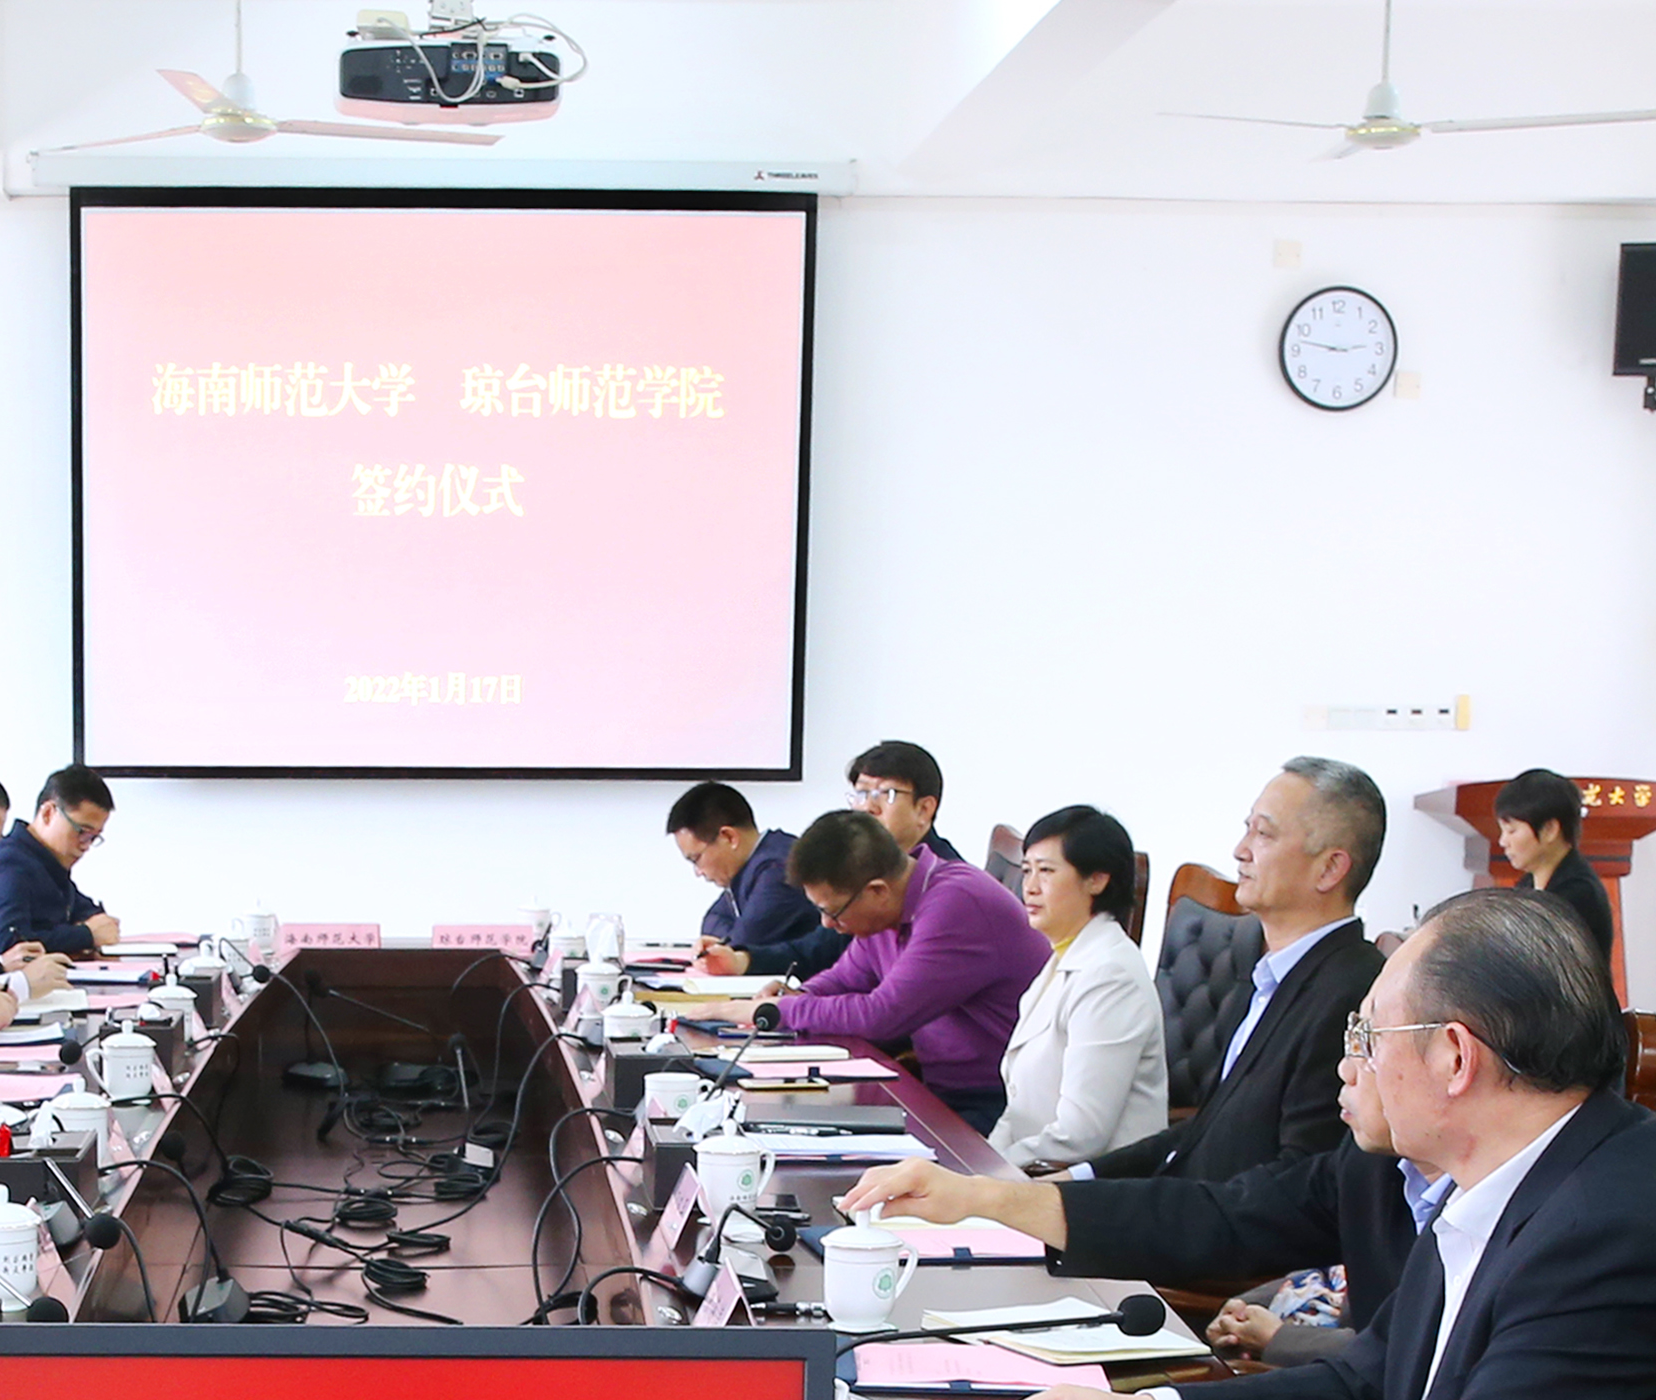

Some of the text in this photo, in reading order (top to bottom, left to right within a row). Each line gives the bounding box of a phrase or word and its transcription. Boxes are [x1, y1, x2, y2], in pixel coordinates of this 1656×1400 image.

[1312, 307, 1324, 320] 11
[1332, 300, 1346, 314] 12
[1297, 323, 1311, 337] 10
[1368, 320, 1378, 334] 2
[1291, 344, 1300, 357] 9
[1375, 342, 1384, 355] 3
[1297, 365, 1307, 378] 8
[1367, 363, 1376, 376] 4
[152, 362, 725, 419] 海南师范大学 琼台师范学院
[1312, 379, 1321, 393] 7
[1354, 378, 1364, 392] 5
[1332, 386, 1342, 399] 6
[351, 463, 525, 517] 签约仪式
[344, 672, 523, 704] 2022年1月17日
